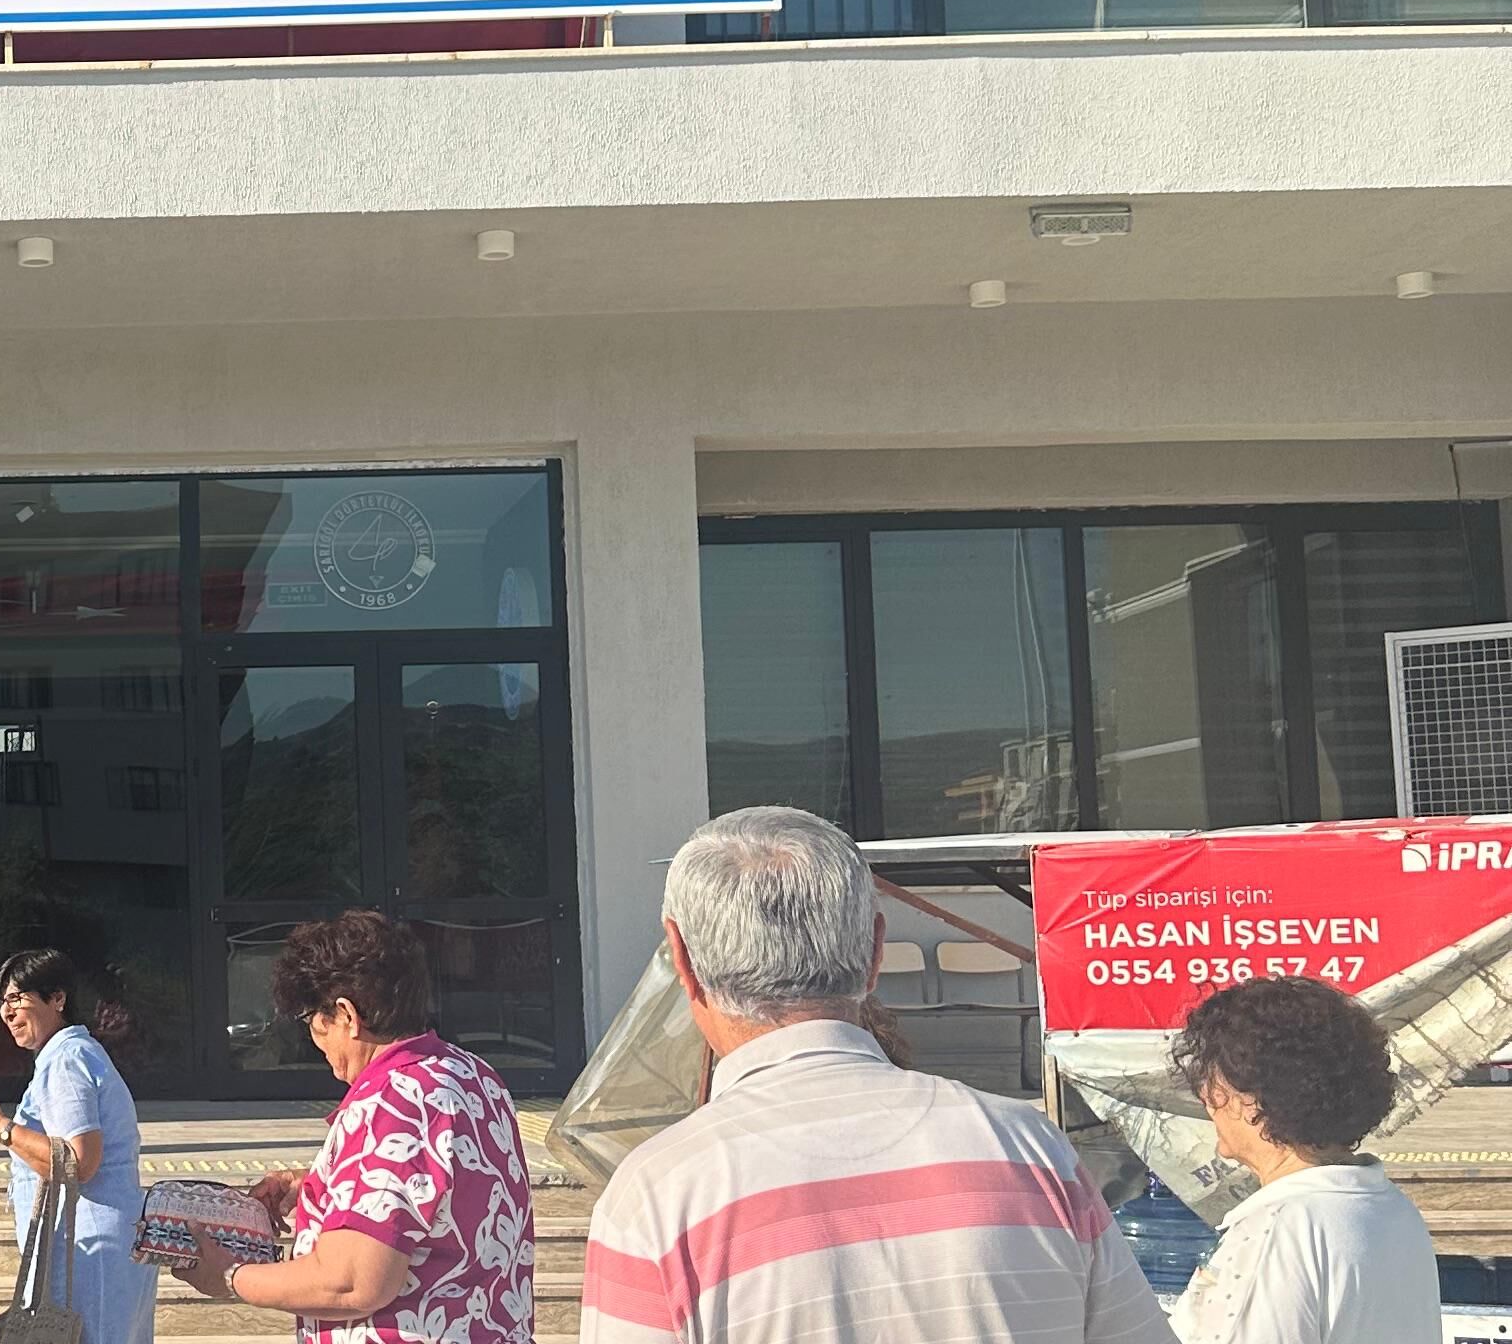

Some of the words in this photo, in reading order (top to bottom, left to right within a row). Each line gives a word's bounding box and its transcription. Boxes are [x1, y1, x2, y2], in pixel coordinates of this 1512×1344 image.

[359, 592, 396, 607] 1968
[1082, 890, 1128, 912] Tüp
[1135, 886, 1217, 909] siparişi
[1225, 886, 1274, 906] için:
[1085, 920, 1210, 948] HASAN
[1223, 915, 1379, 950] İŞSEVEN
[1087, 958, 1176, 985] 0554
[1187, 958, 1253, 984] 936
[1266, 957, 1308, 981] 57
[1319, 956, 1365, 983] 47
